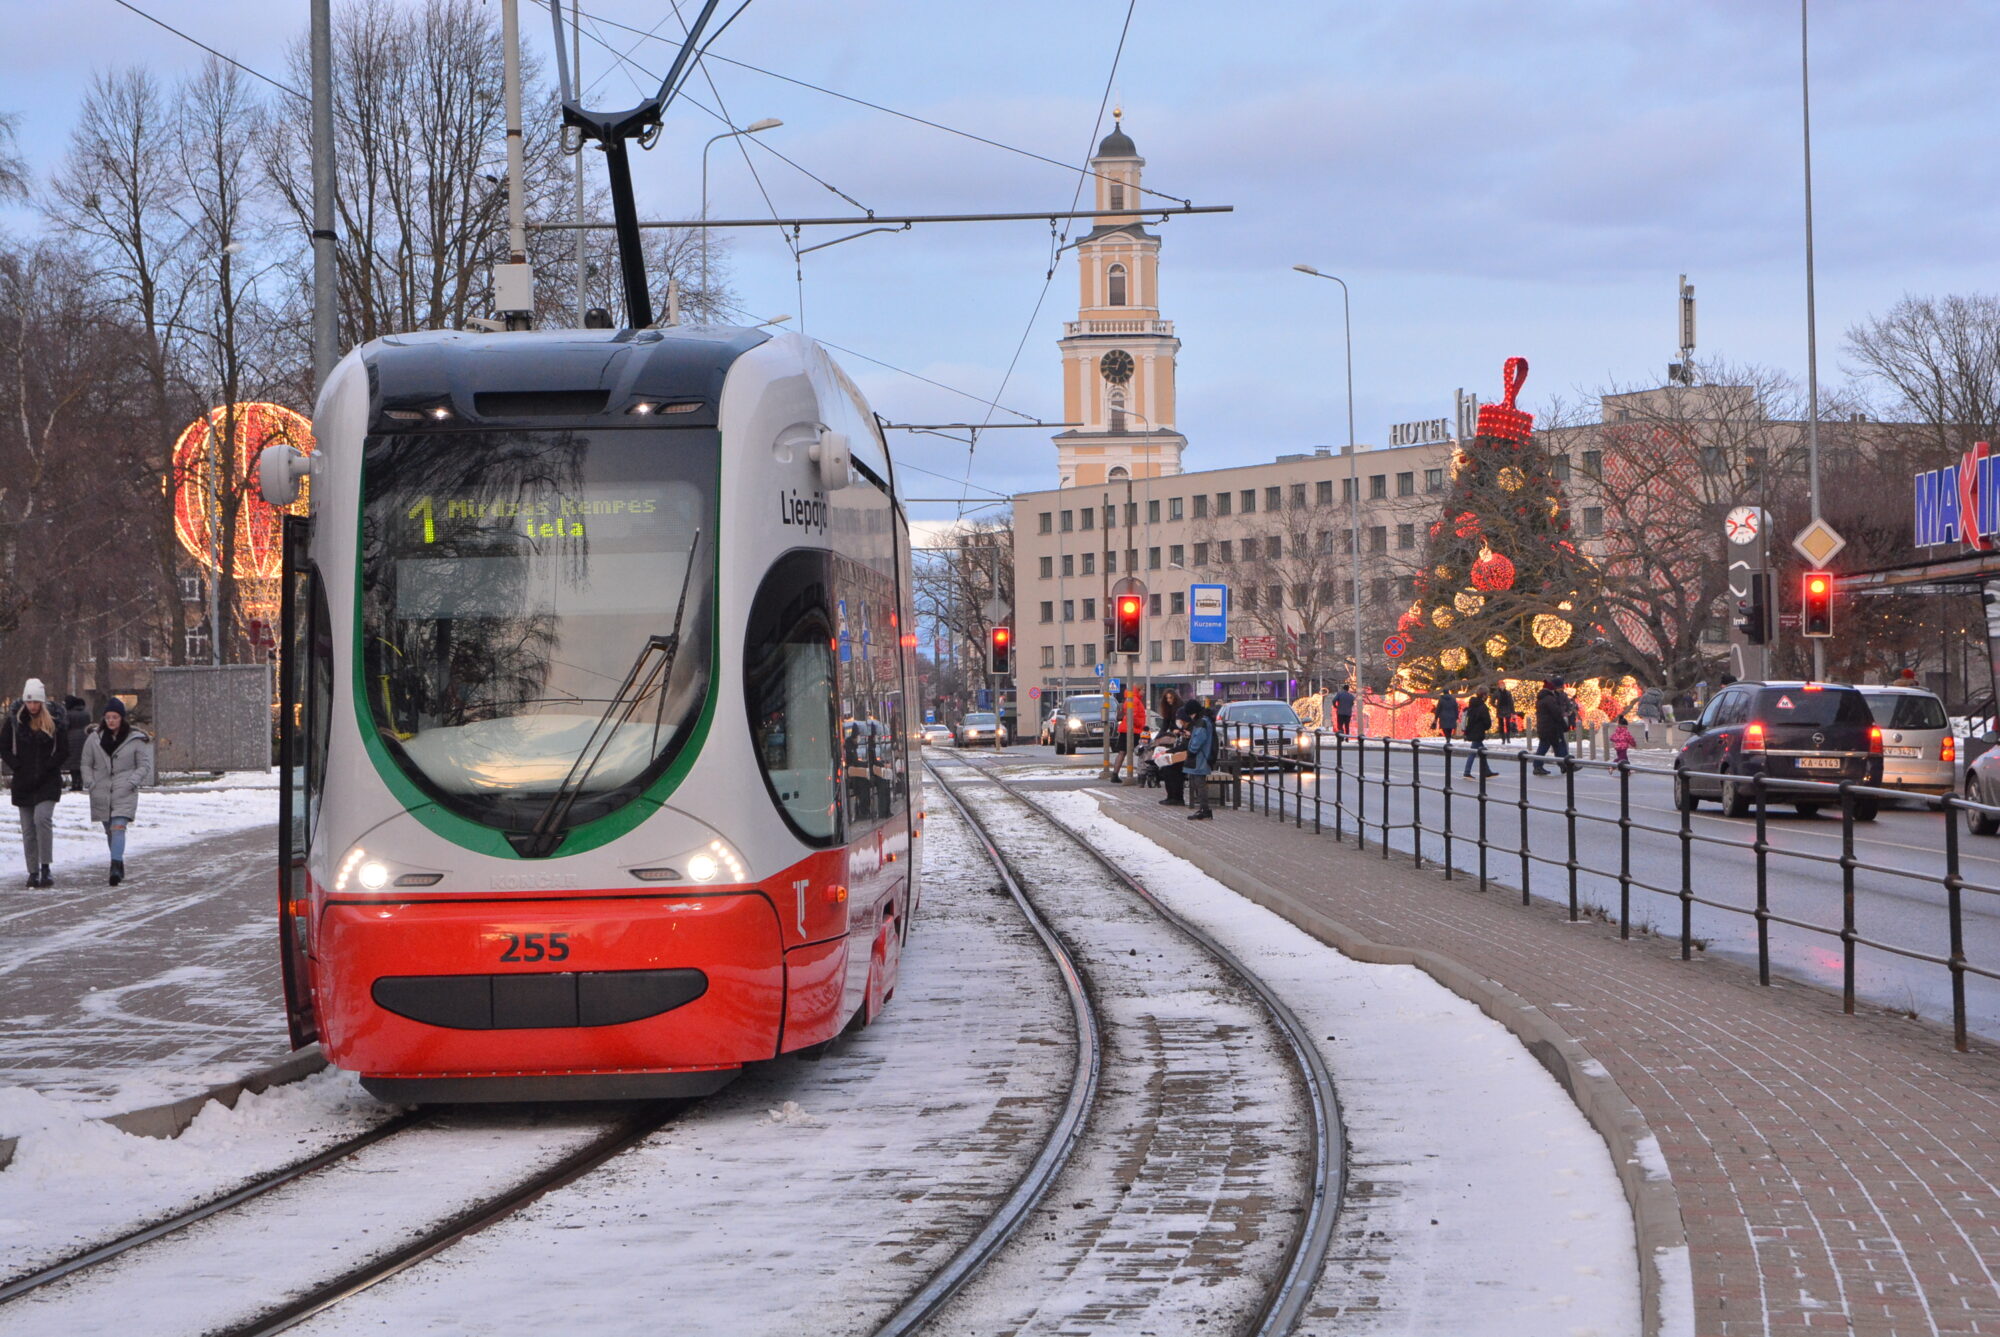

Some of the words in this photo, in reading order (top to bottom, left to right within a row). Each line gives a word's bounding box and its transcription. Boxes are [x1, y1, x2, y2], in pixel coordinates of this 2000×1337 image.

[1389, 418, 1451, 446] HOTEL
[408, 495, 435, 544] 1
[449, 499, 550, 518] Mirdzas
[560, 499, 657, 517] Kempes
[780, 488, 828, 536] Liepāja
[526, 518, 584, 537] iela
[499, 933, 570, 962] 255
